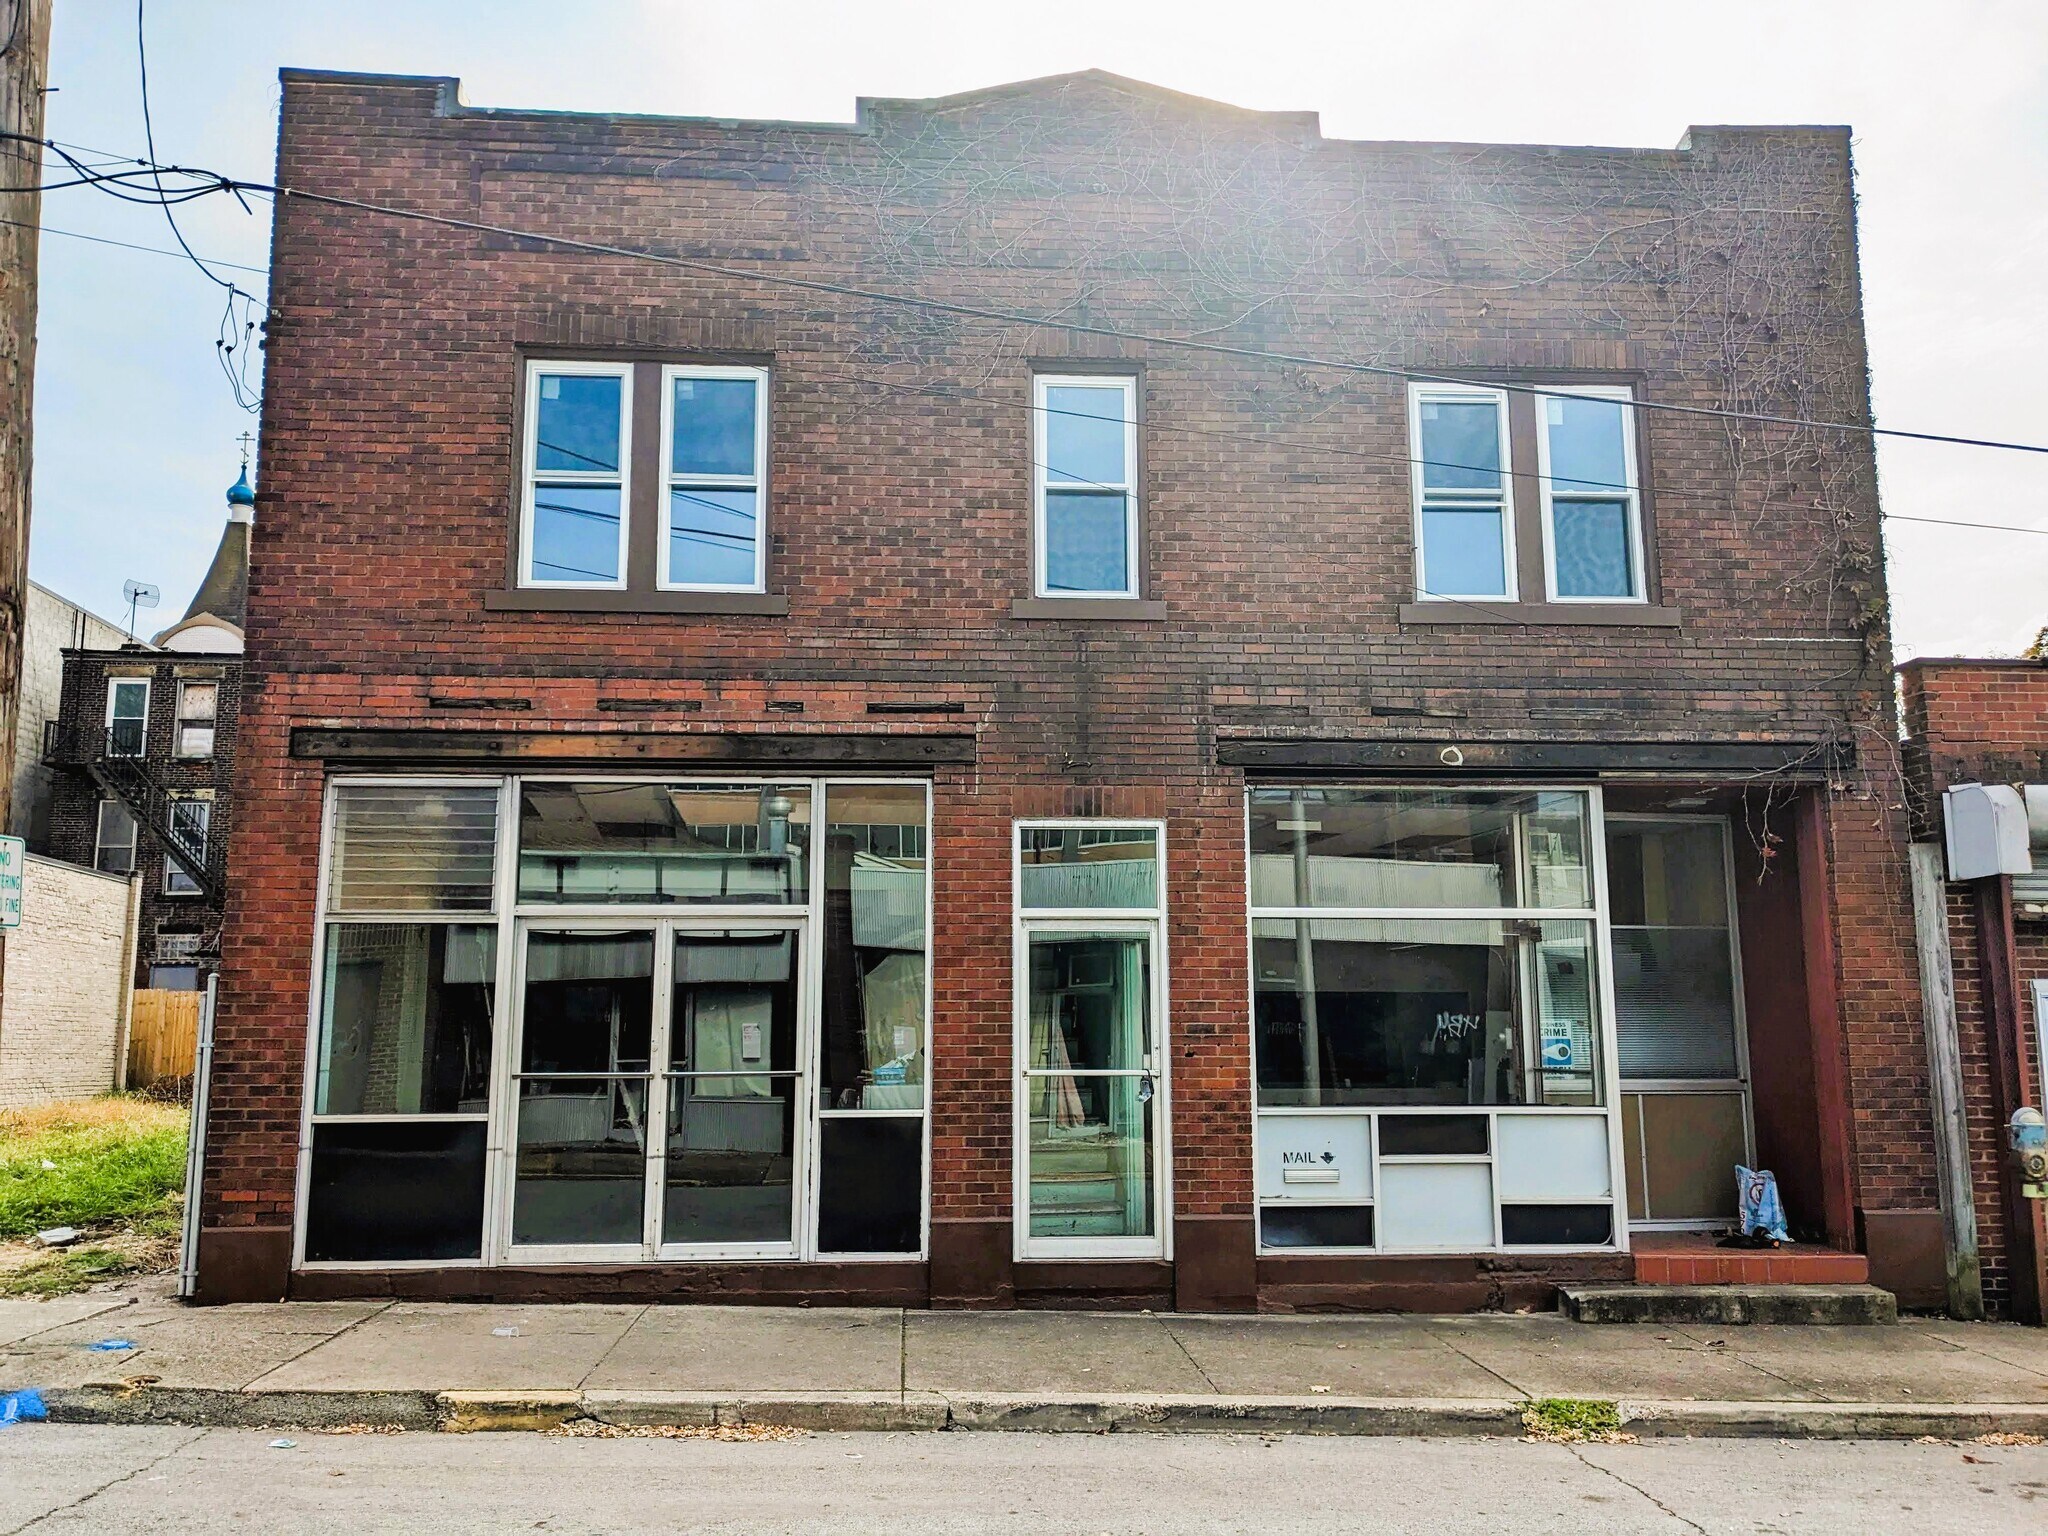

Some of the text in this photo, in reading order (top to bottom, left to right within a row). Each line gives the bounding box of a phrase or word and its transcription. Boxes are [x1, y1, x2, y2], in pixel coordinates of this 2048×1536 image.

[0, 851, 11, 866] NO
[0, 874, 20, 890] ERING
[5, 898, 19, 913] FINE
[1283, 1152, 1316, 1163] MAIL
